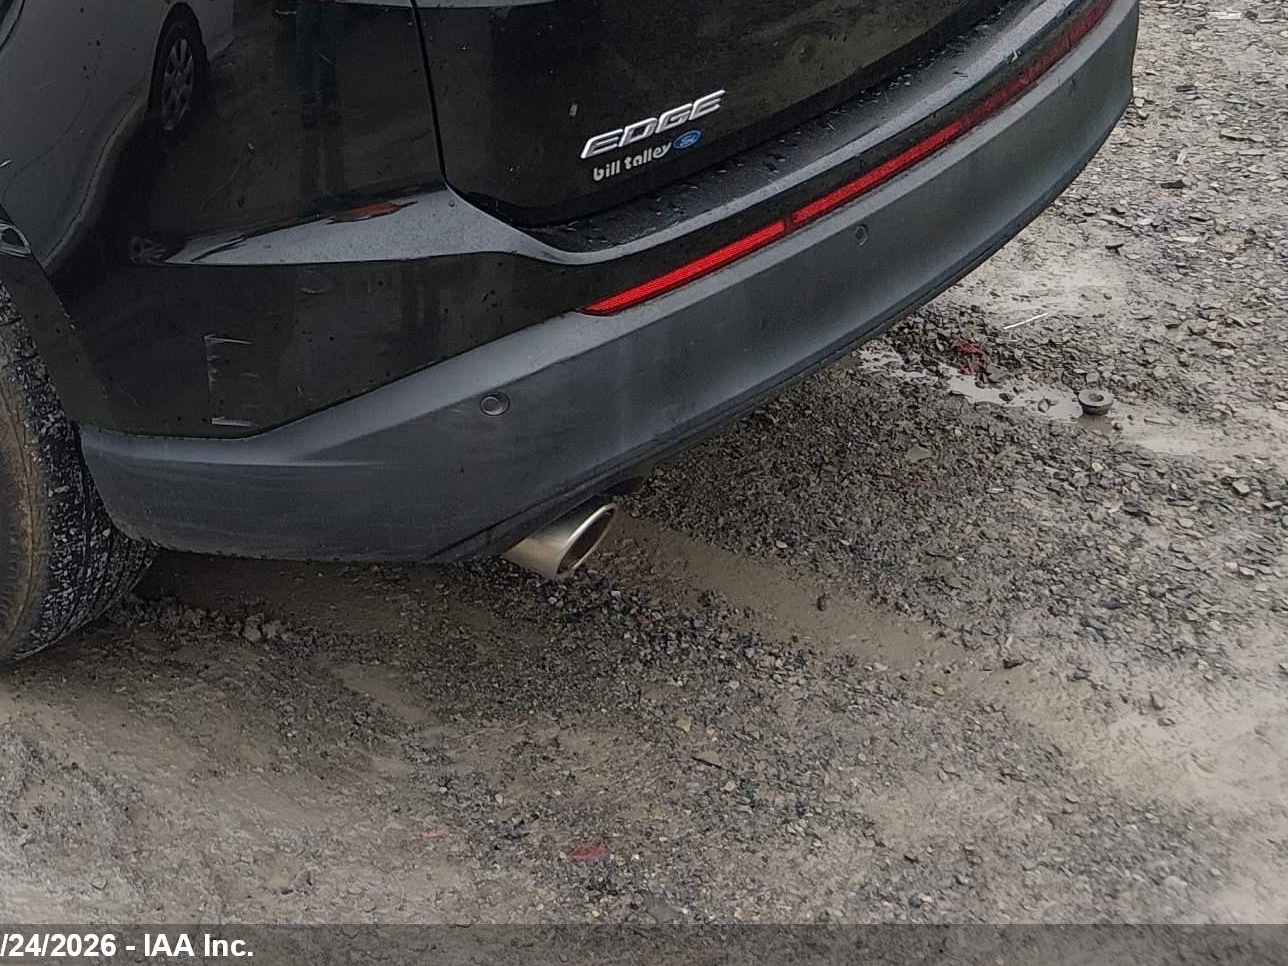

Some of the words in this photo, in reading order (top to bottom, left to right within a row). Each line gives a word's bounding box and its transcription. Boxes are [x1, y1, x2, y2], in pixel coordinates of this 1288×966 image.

[580, 89, 727, 159] EDGE
[593, 159, 620, 182] bill
[624, 141, 672, 170] talley
